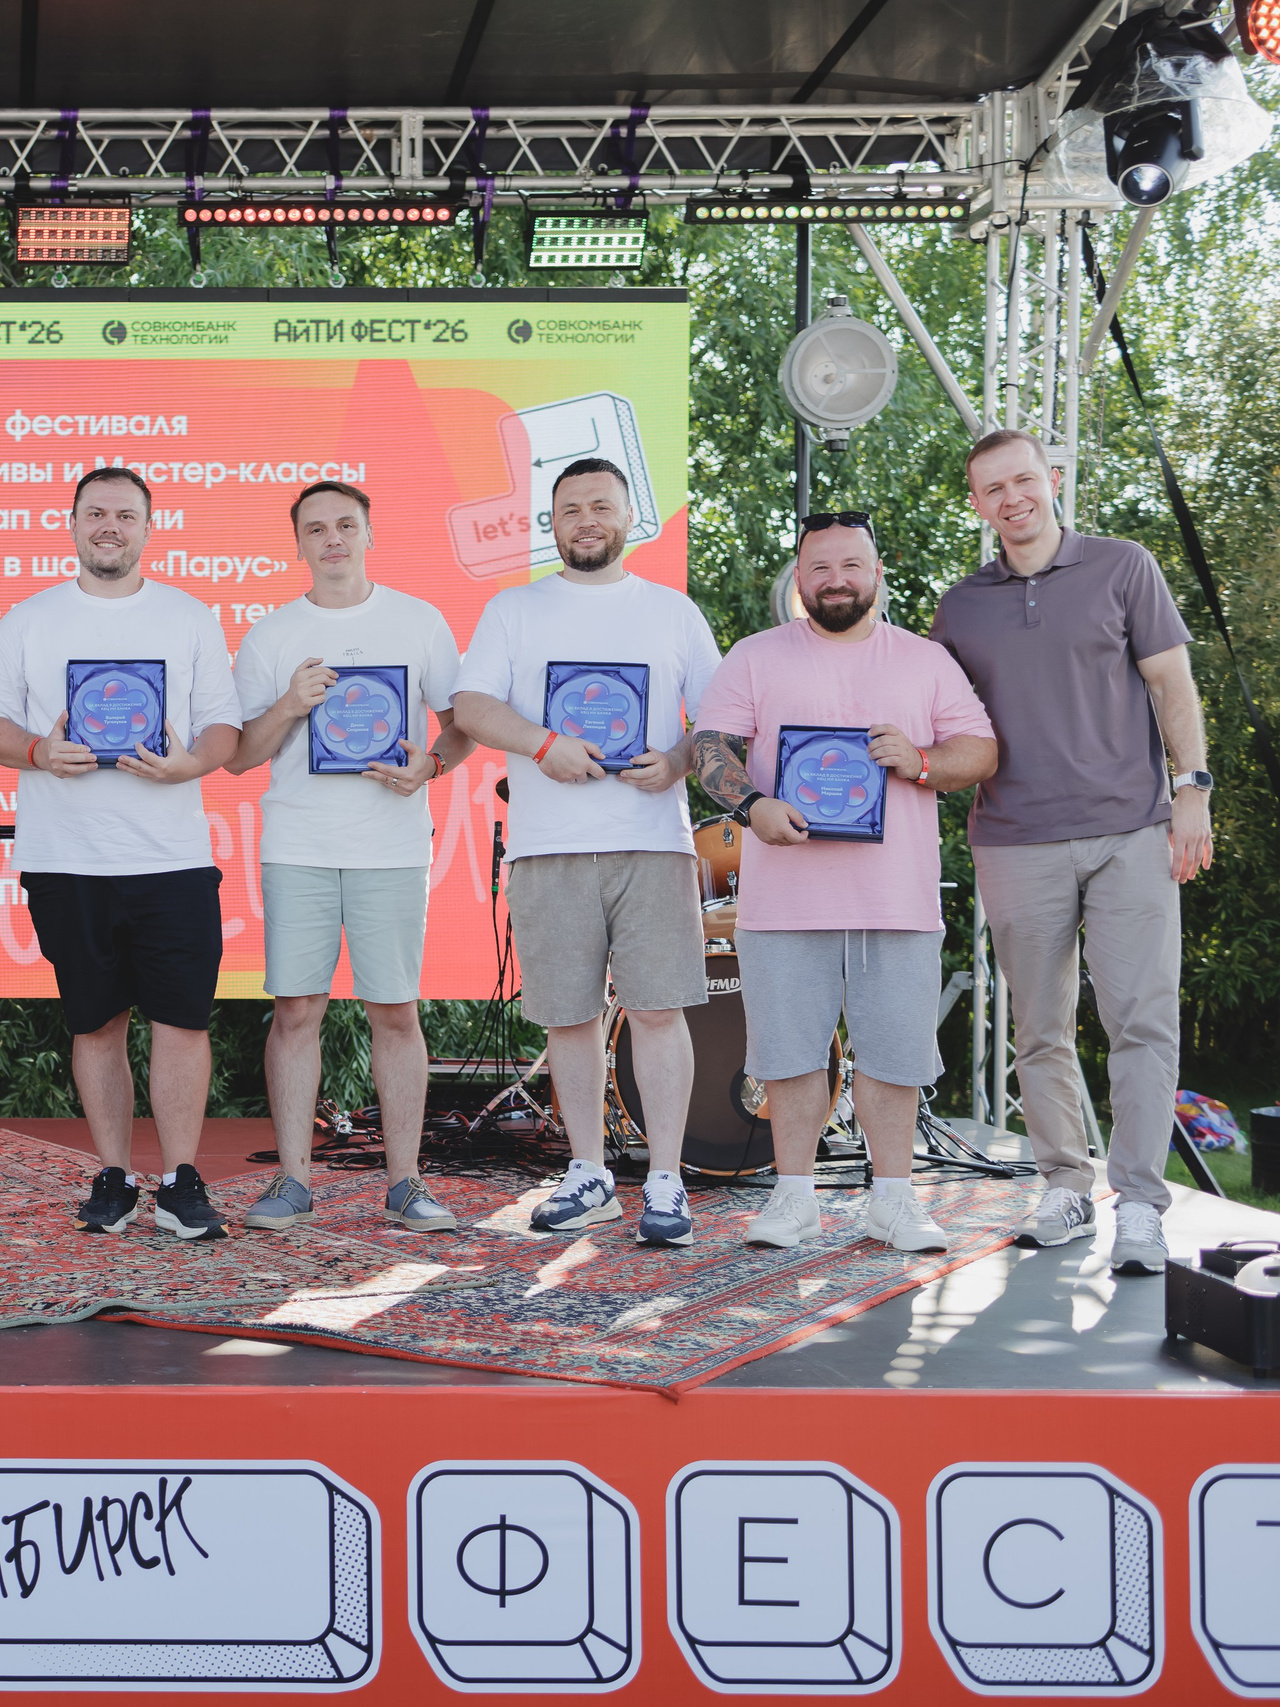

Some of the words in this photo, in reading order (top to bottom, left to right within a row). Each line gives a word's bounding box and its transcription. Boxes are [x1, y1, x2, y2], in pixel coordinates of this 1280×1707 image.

[131, 321, 237, 333] СОВКОМБАНК
[536, 320, 643, 332] СОВКОМБАНК
[132, 333, 230, 345] ТЕХНОЛОГИИ
[537, 333, 636, 344] ТЕХНОЛОГИИ
[5, 409, 188, 442] фестиваля
[63, 462, 85, 484] и
[472, 511, 531, 543] let's
[537, 510, 553, 533] g
[3, 557, 22, 577] в
[150, 550, 289, 583] «Парус»
